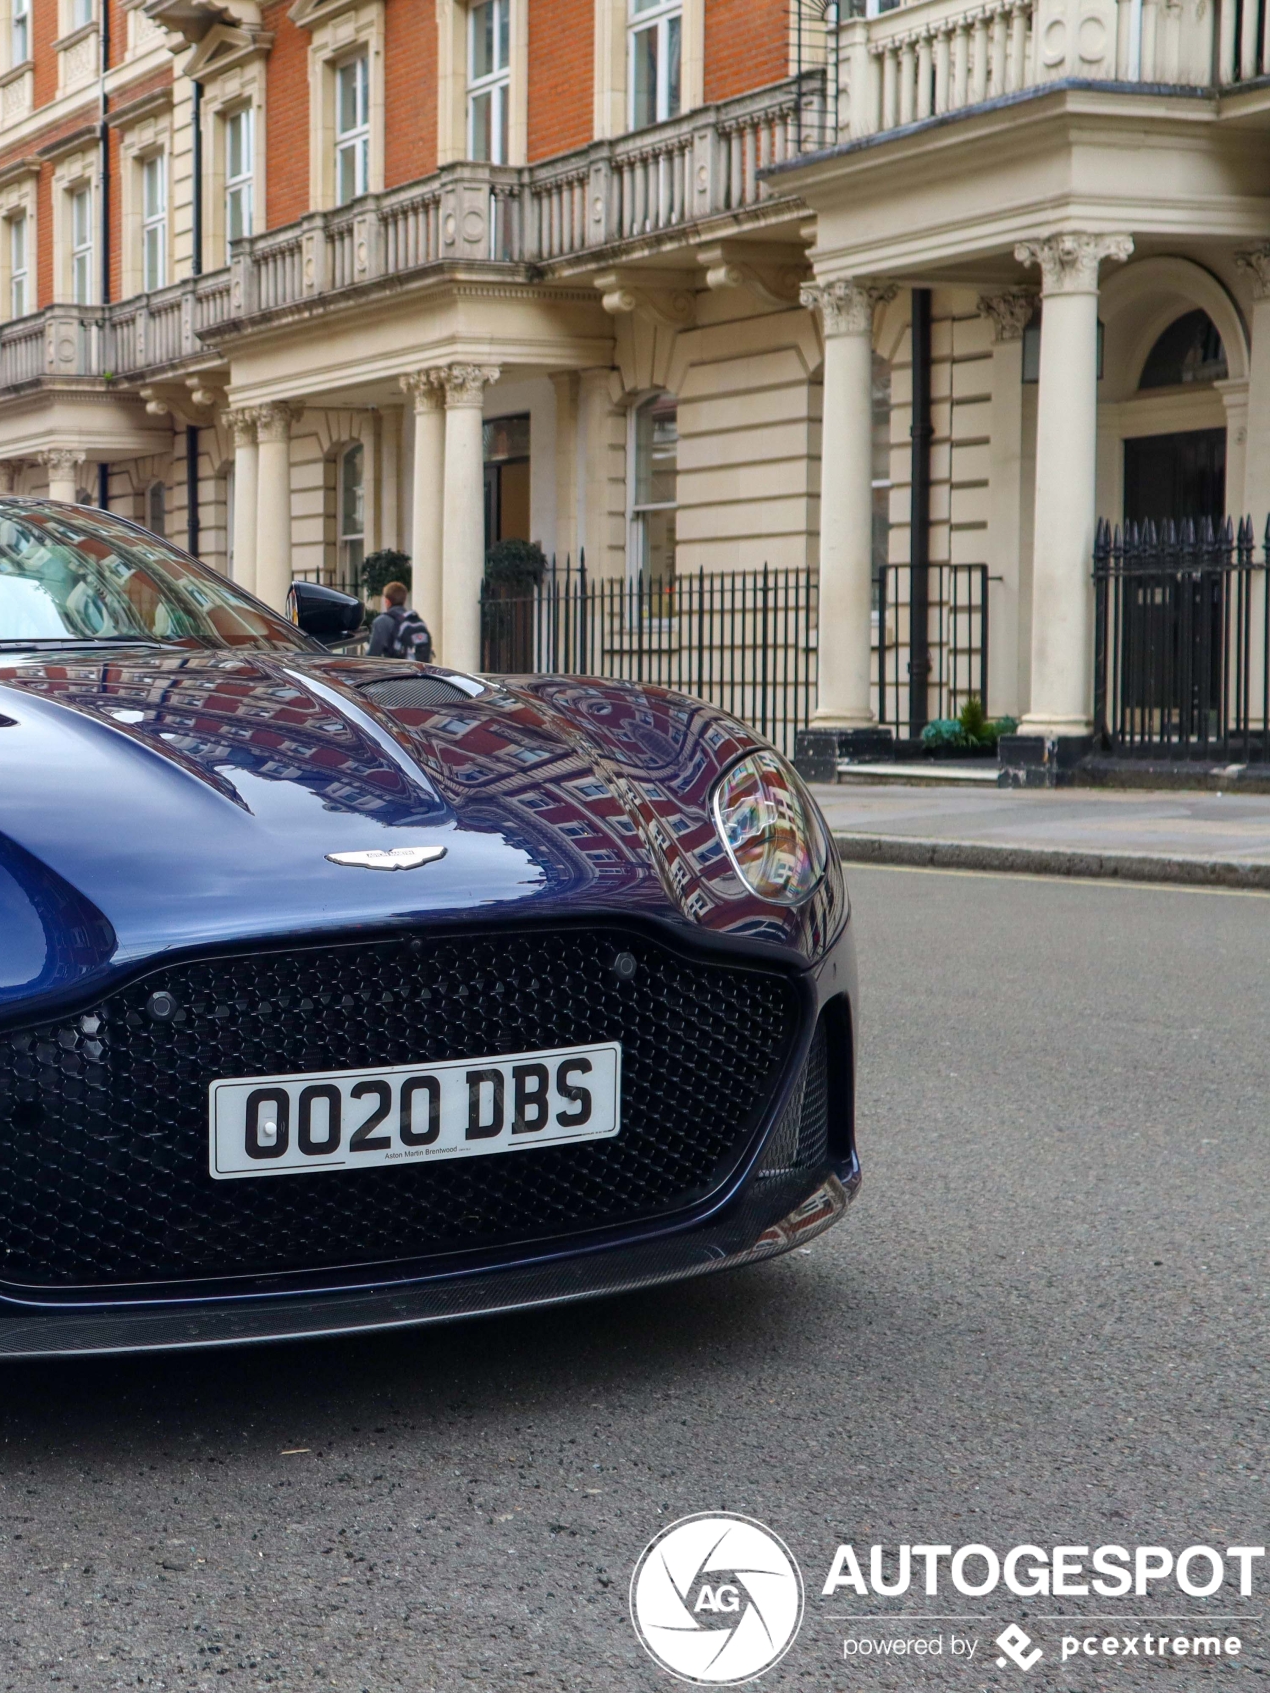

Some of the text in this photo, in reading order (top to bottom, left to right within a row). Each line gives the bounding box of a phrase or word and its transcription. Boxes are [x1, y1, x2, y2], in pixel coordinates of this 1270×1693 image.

[465, 1057, 593, 1141] DBS
[385, 1152, 403, 1160] Aston
[404, 1149, 424, 1158] Martin
[425, 1146, 458, 1156] Brentwood
